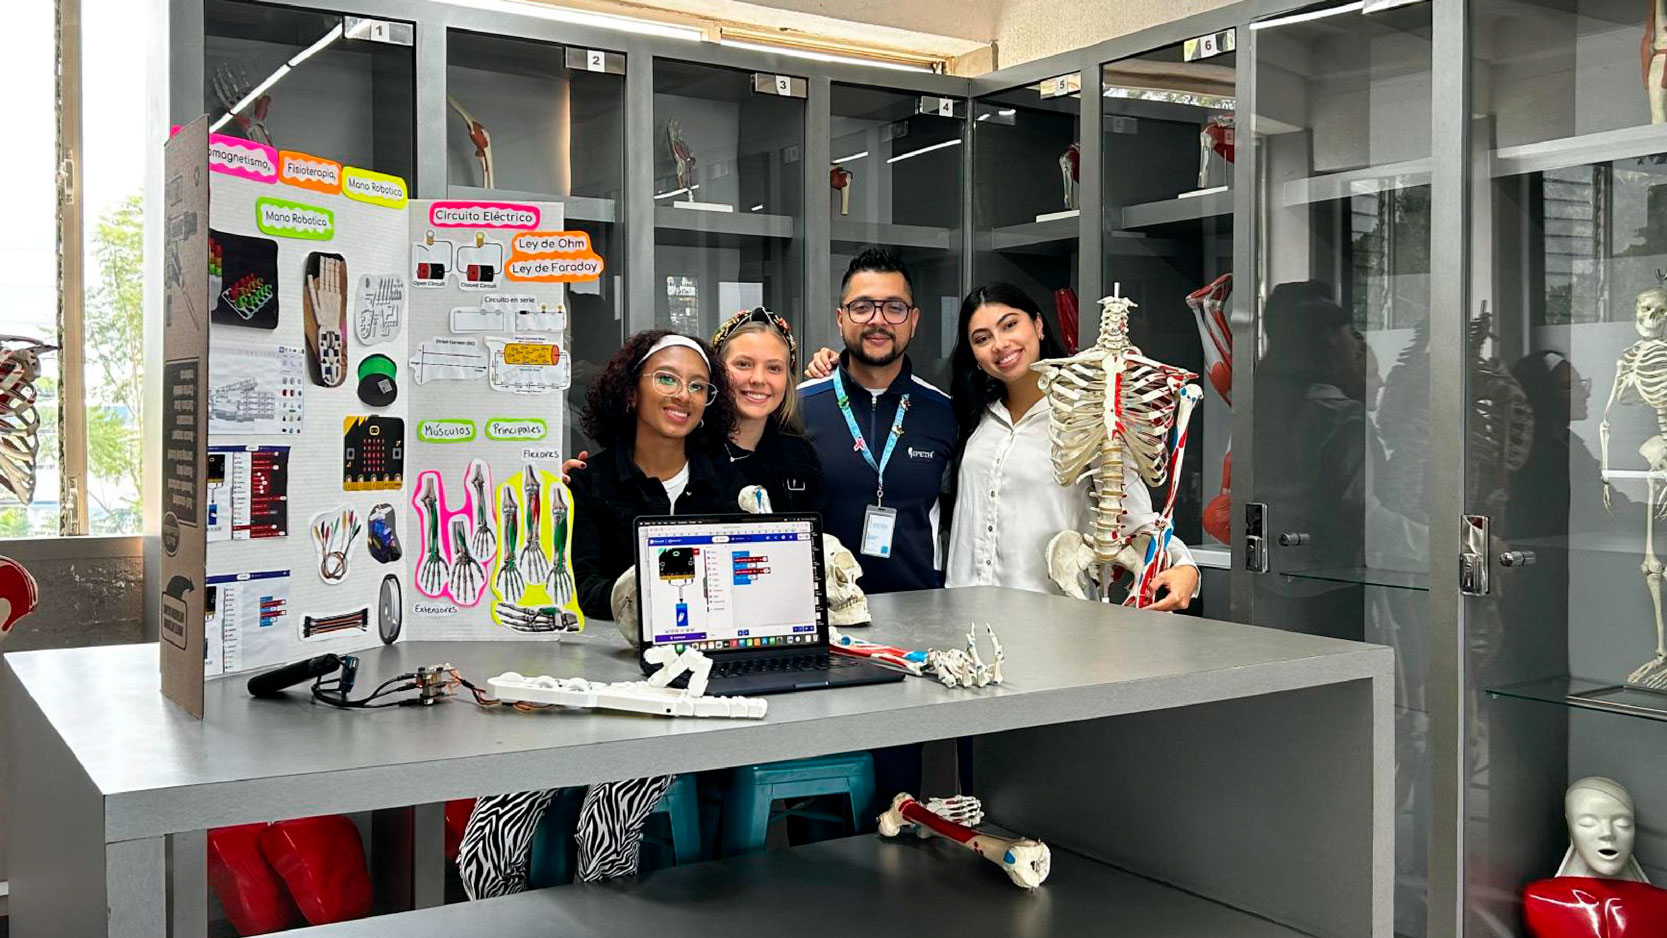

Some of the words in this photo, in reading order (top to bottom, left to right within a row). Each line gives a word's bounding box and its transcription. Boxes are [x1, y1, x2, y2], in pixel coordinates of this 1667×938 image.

[376, 25, 383, 36] 1
[1204, 40, 1212, 51] 6
[592, 55, 600, 66] 2
[779, 79, 787, 90] 3
[1059, 81, 1065, 90] 5
[942, 102, 950, 112] 4
[287, 163, 337, 180] Fisioterapia,
[348, 178, 370, 191] Mano
[265, 211, 290, 223] Mano
[292, 213, 328, 226] Robotica
[435, 210, 480, 222] Circuito
[483, 211, 533, 223] Eléctrico
[519, 238, 538, 250] Ley
[542, 238, 554, 248] de
[558, 238, 585, 249] Ohm
[512, 264, 532, 275] Ley
[534, 263, 549, 273] de
[551, 262, 598, 275] Faraday
[484, 296, 508, 304] Circuito
[425, 423, 471, 437] Músculos
[493, 422, 542, 435] Principales
[523, 449, 560, 460] Flexores
[415, 604, 457, 614] Extensores
